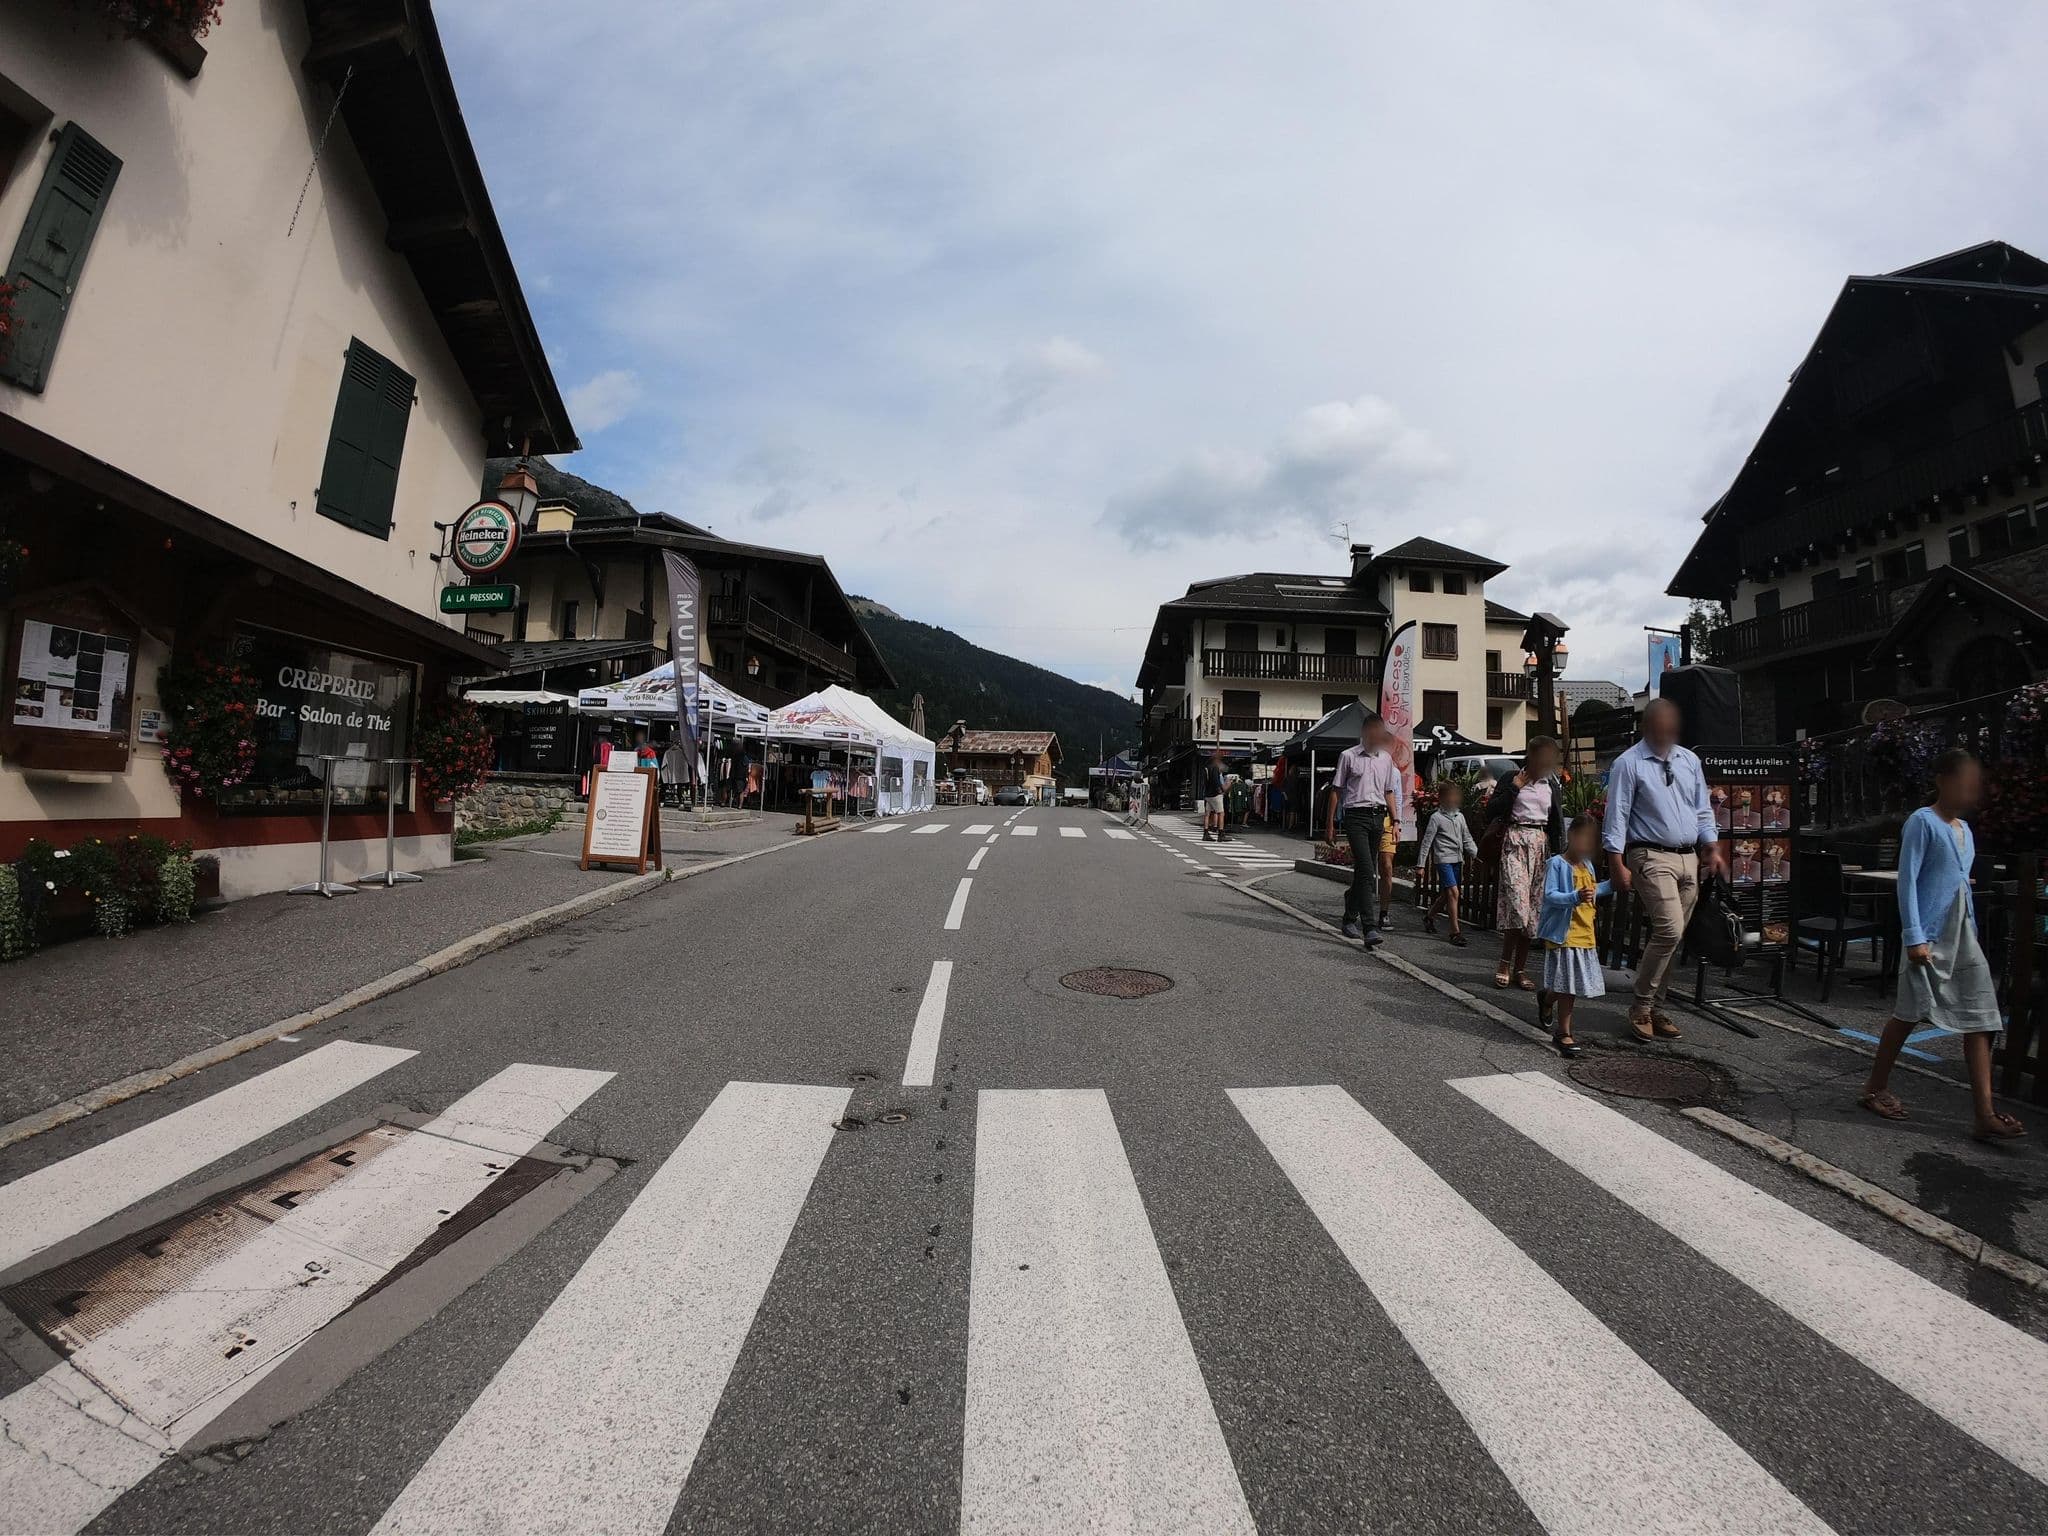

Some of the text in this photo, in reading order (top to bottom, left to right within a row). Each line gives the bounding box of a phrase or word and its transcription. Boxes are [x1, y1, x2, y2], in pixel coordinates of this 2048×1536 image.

[459, 529, 505, 542] Heineken
[446, 592, 504, 603] A LA PRESSION
[278, 665, 376, 701] CRÊPERIE
[1389, 660, 1402, 725] Glaces
[1400, 646, 1410, 713] Artisanales
[255, 698, 287, 718] Bar
[299, 704, 342, 726] Salon
[346, 711, 363, 728] de
[367, 714, 392, 731] Thé
[1741, 757, 1753, 766] Les
[1755, 757, 1784, 766] Airelles
